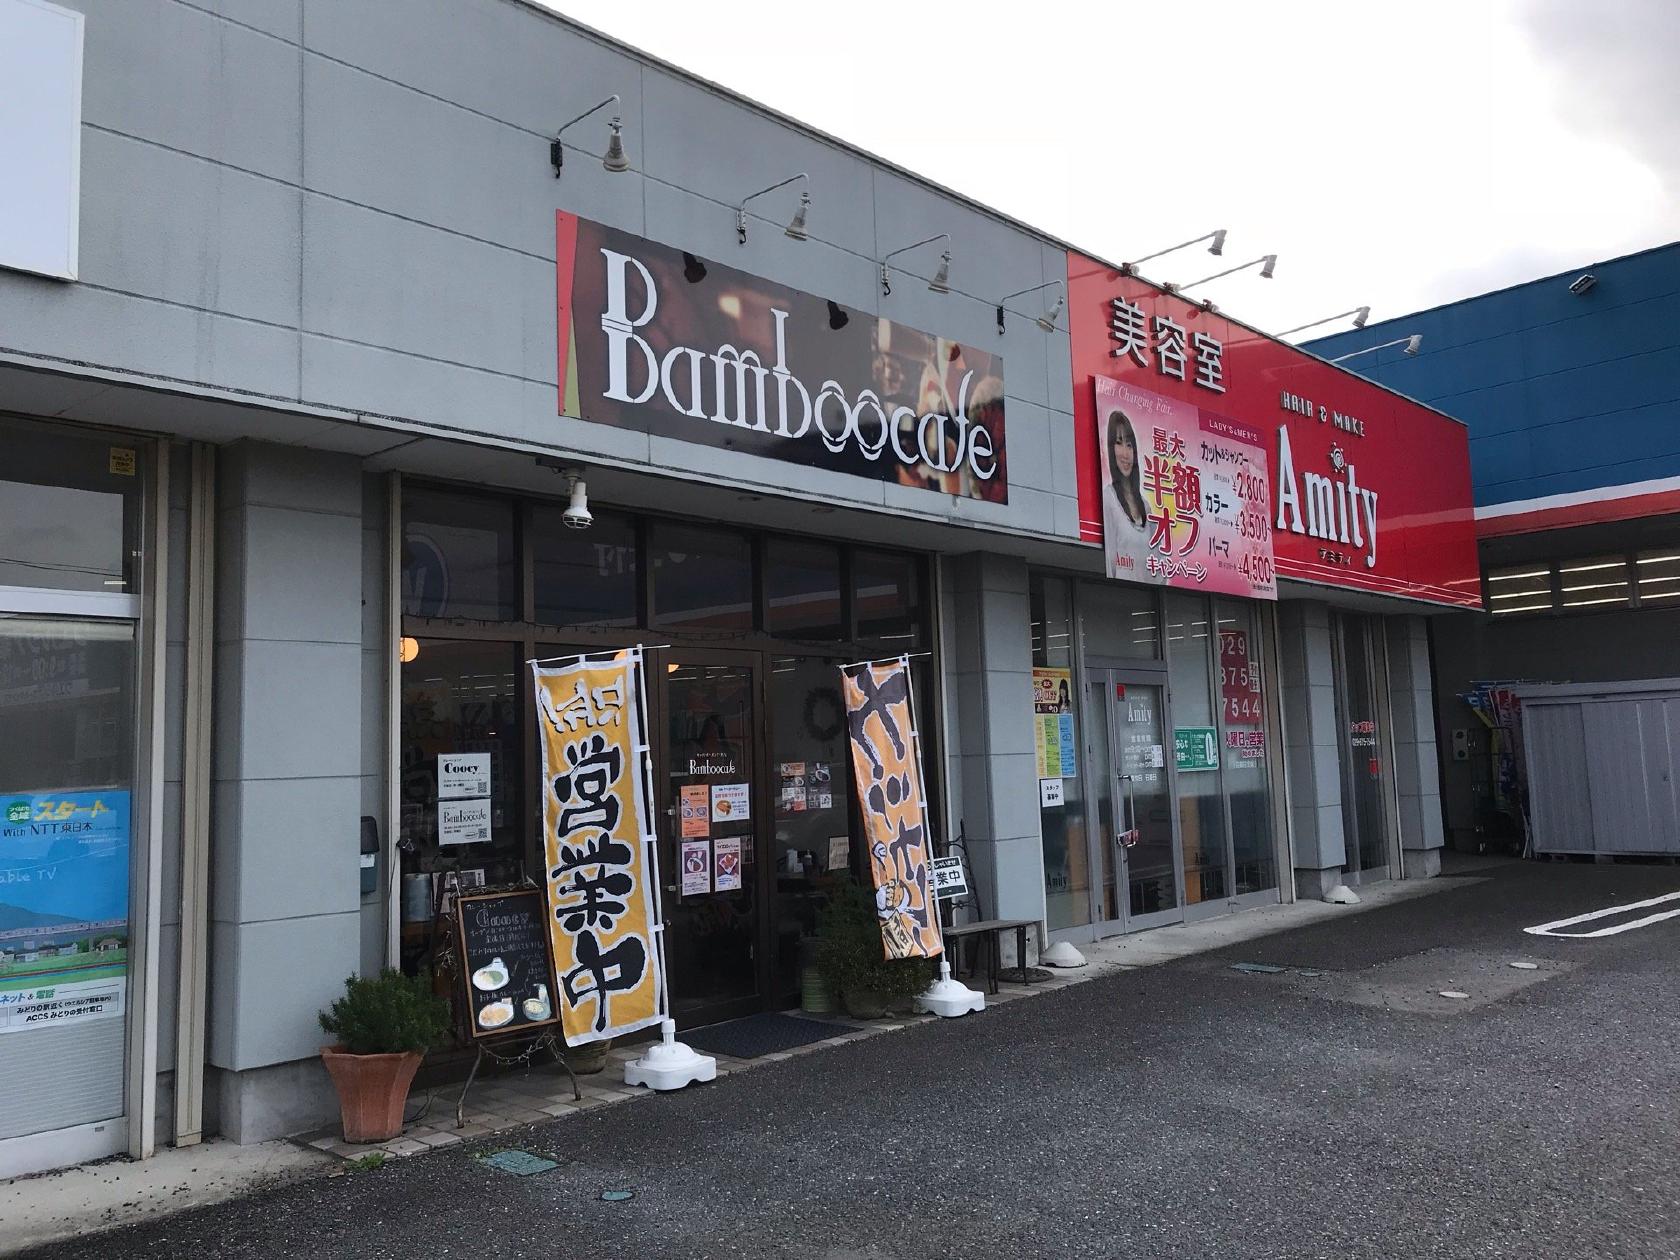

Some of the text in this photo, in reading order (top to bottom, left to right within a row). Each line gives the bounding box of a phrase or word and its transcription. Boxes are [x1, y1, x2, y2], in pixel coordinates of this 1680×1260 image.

[1112, 296, 1226, 394] 美容室
[600, 247, 997, 480] Bamboocafe
[1118, 386, 1153, 413] Changing
[1283, 391, 1366, 437] HAIR & MAKE
[1152, 427, 1186, 461] 最大
[1143, 455, 1203, 516] 半額
[1232, 472, 1266, 505] ¥2,800
[1277, 424, 1379, 569] Amity
[1205, 493, 1229, 514] カラー
[1147, 508, 1200, 555] オフ
[1115, 551, 1135, 572] Amity
[1146, 555, 1208, 582] キャンペーン
[1128, 703, 1152, 725] Amity
[33, 800, 109, 821] スタート
[3, 822, 93, 838] With NTT 東日本
[36, 867, 57, 881] TV
[929, 870, 961, 887] 業中
[36, 988, 56, 1000] 電話
[26, 1012, 49, 1023] ACCS
